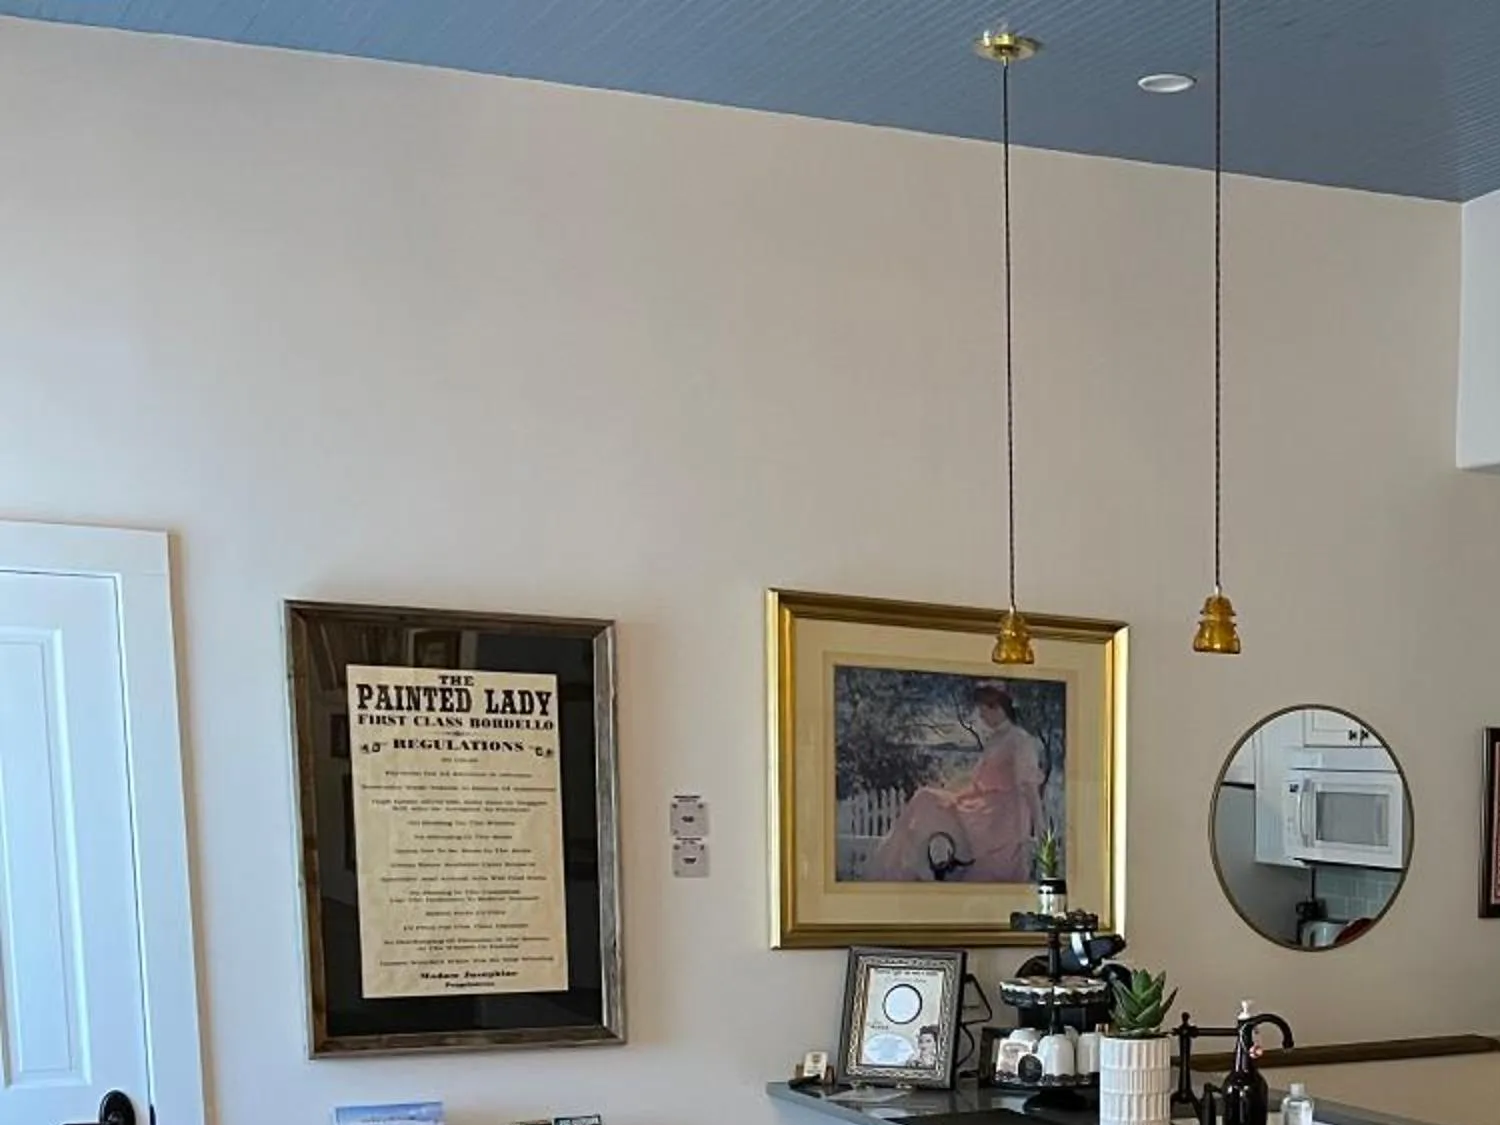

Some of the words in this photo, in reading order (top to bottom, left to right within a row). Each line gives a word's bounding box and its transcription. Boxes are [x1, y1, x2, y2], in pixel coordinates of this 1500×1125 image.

[438, 675, 475, 686] THE
[356, 684, 473, 713] PAINTED
[484, 689, 552, 716] LADY
[357, 714, 407, 726] FIRST
[413, 715, 463, 727] CLASS
[469, 718, 554, 731] BORDELLO
[393, 739, 525, 752] REGULATIONS
